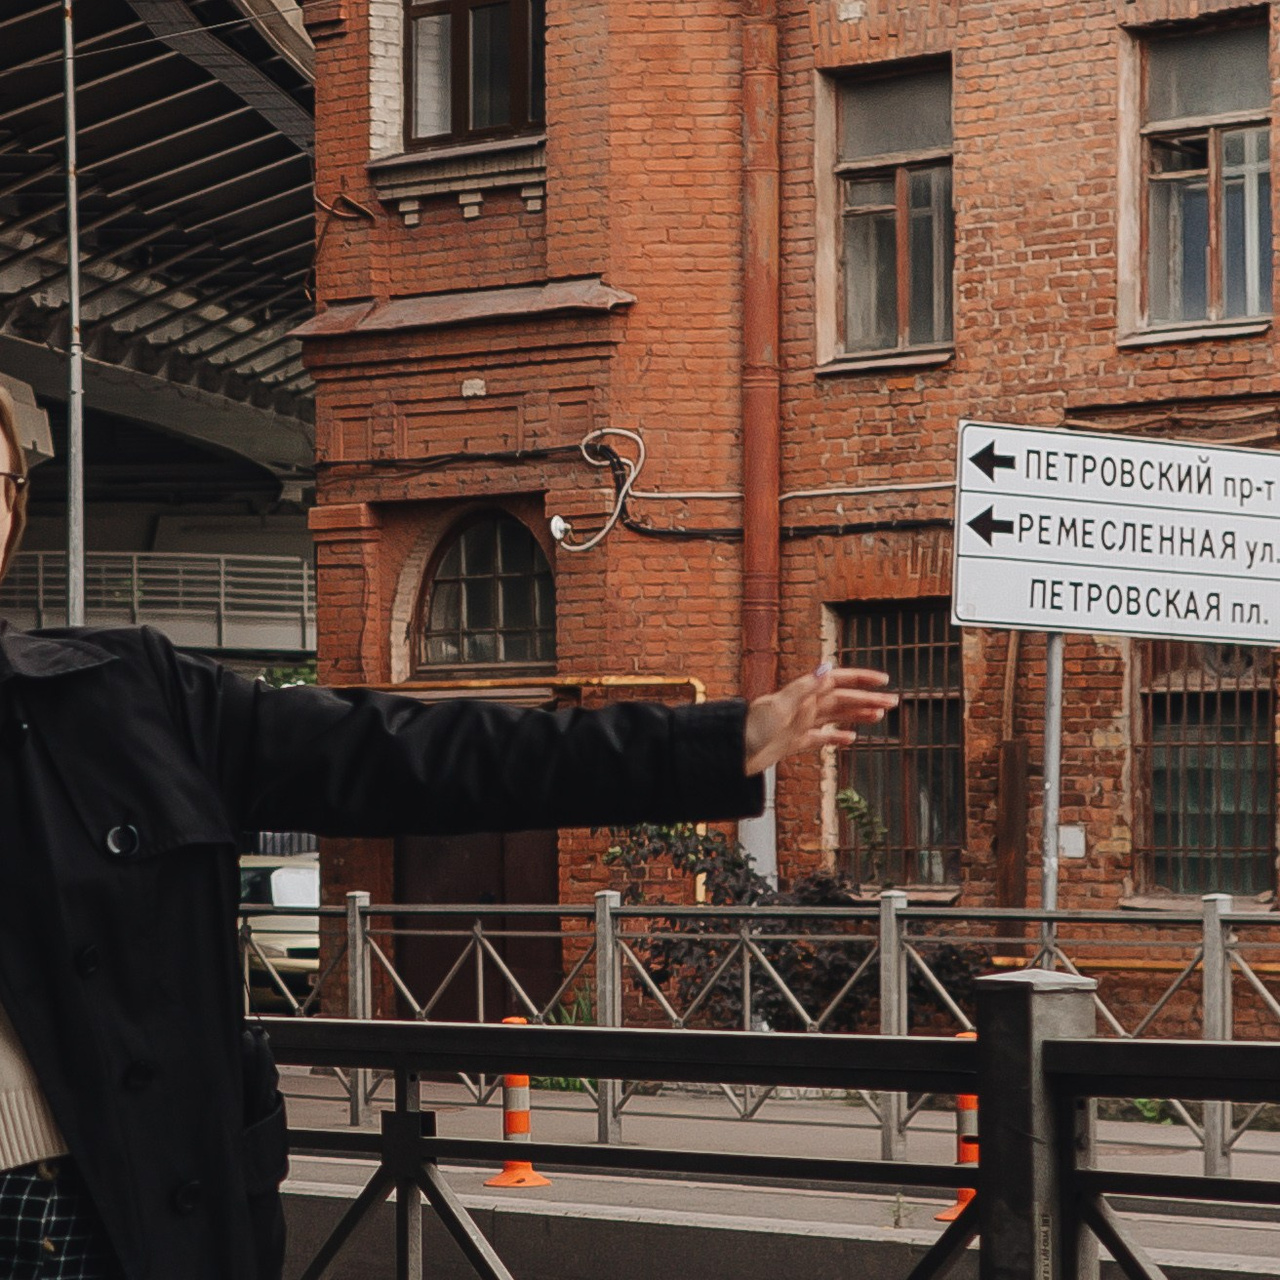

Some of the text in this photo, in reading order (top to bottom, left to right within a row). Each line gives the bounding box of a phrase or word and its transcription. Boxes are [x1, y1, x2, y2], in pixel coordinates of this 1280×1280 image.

[1025, 449, 1276, 507] ПЕТРОВСКИЙ пр-т
[1018, 513, 1280, 569] РЕМЕСЛЕННАЯ ул.
[1029, 579, 1270, 625] ПЕТРОВСКАЯ пл.
